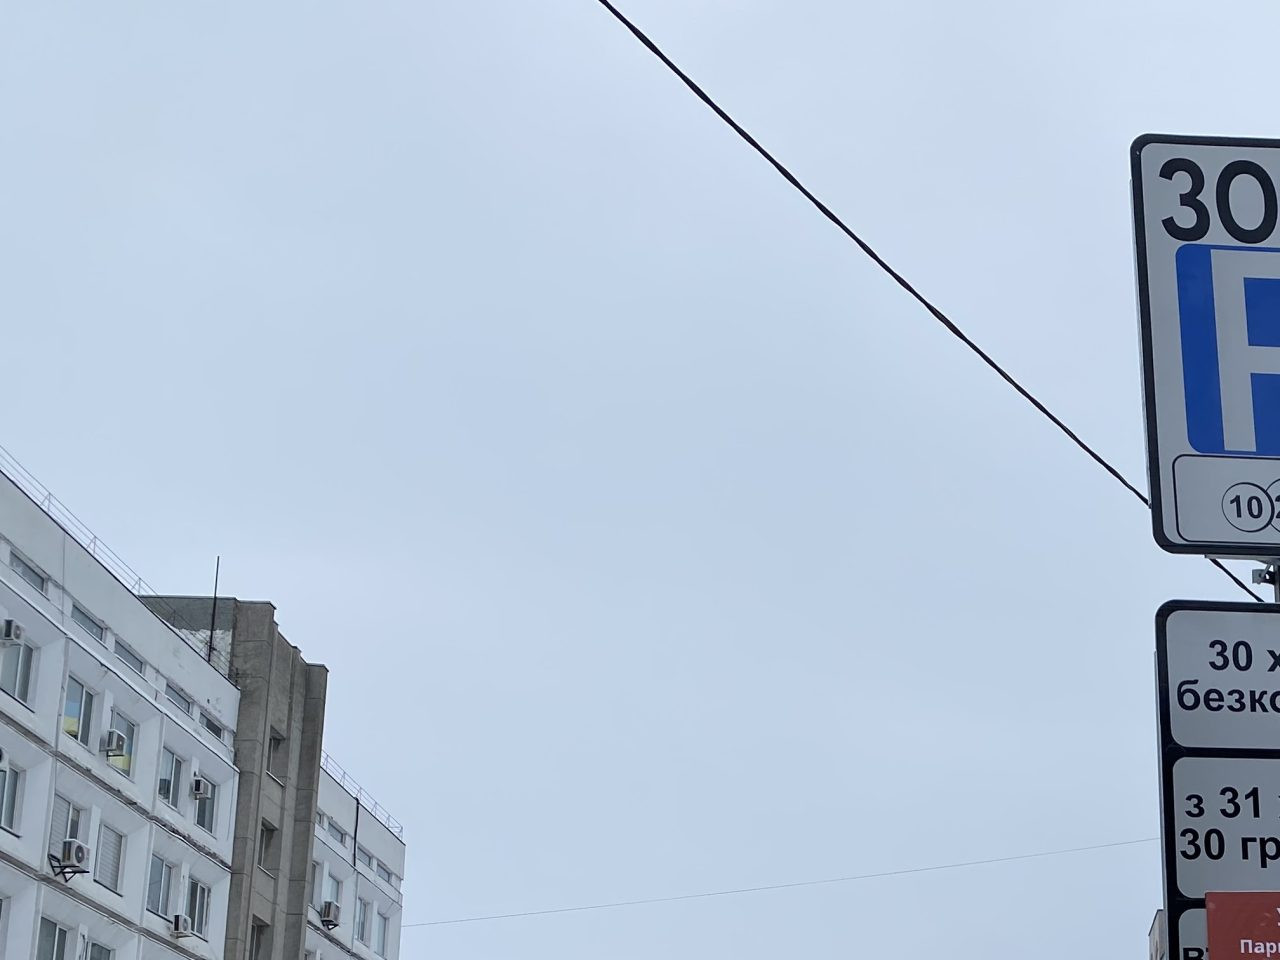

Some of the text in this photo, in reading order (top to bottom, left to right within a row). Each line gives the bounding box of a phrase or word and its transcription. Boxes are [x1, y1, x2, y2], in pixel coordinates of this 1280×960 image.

[1229, 494, 1263, 519] 10
[1208, 640, 1253, 671] 30
[1185, 794, 1206, 818] з
[1219, 787, 1261, 818] 31
[1179, 828, 1225, 860] 30
